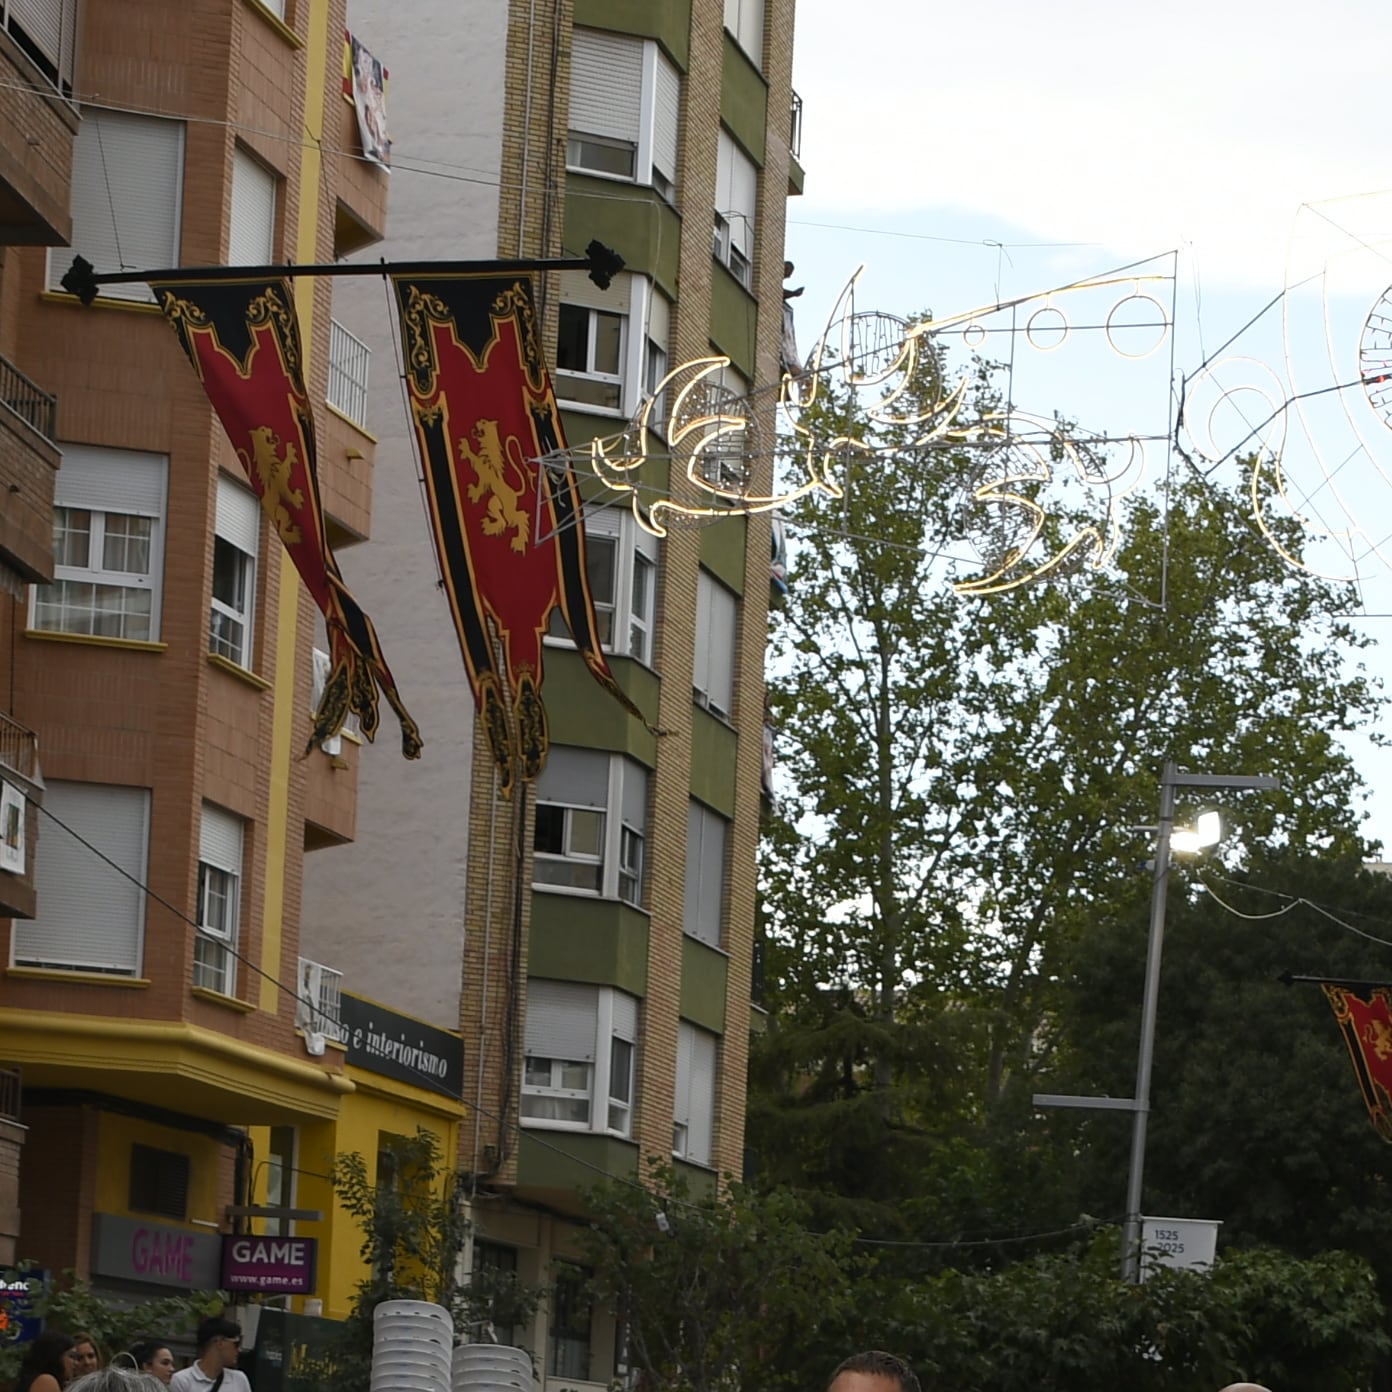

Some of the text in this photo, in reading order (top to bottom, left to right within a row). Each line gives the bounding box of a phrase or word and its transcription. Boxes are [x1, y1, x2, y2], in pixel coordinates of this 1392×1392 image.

[365, 1021, 448, 1078] interiorismo
[1154, 1229, 1179, 1241] 1525
[131, 1228, 196, 1282] GAME
[232, 1241, 305, 1266] GAME
[1157, 1242, 1185, 1254] 2025
[230, 1274, 304, 1287] www.game.es
